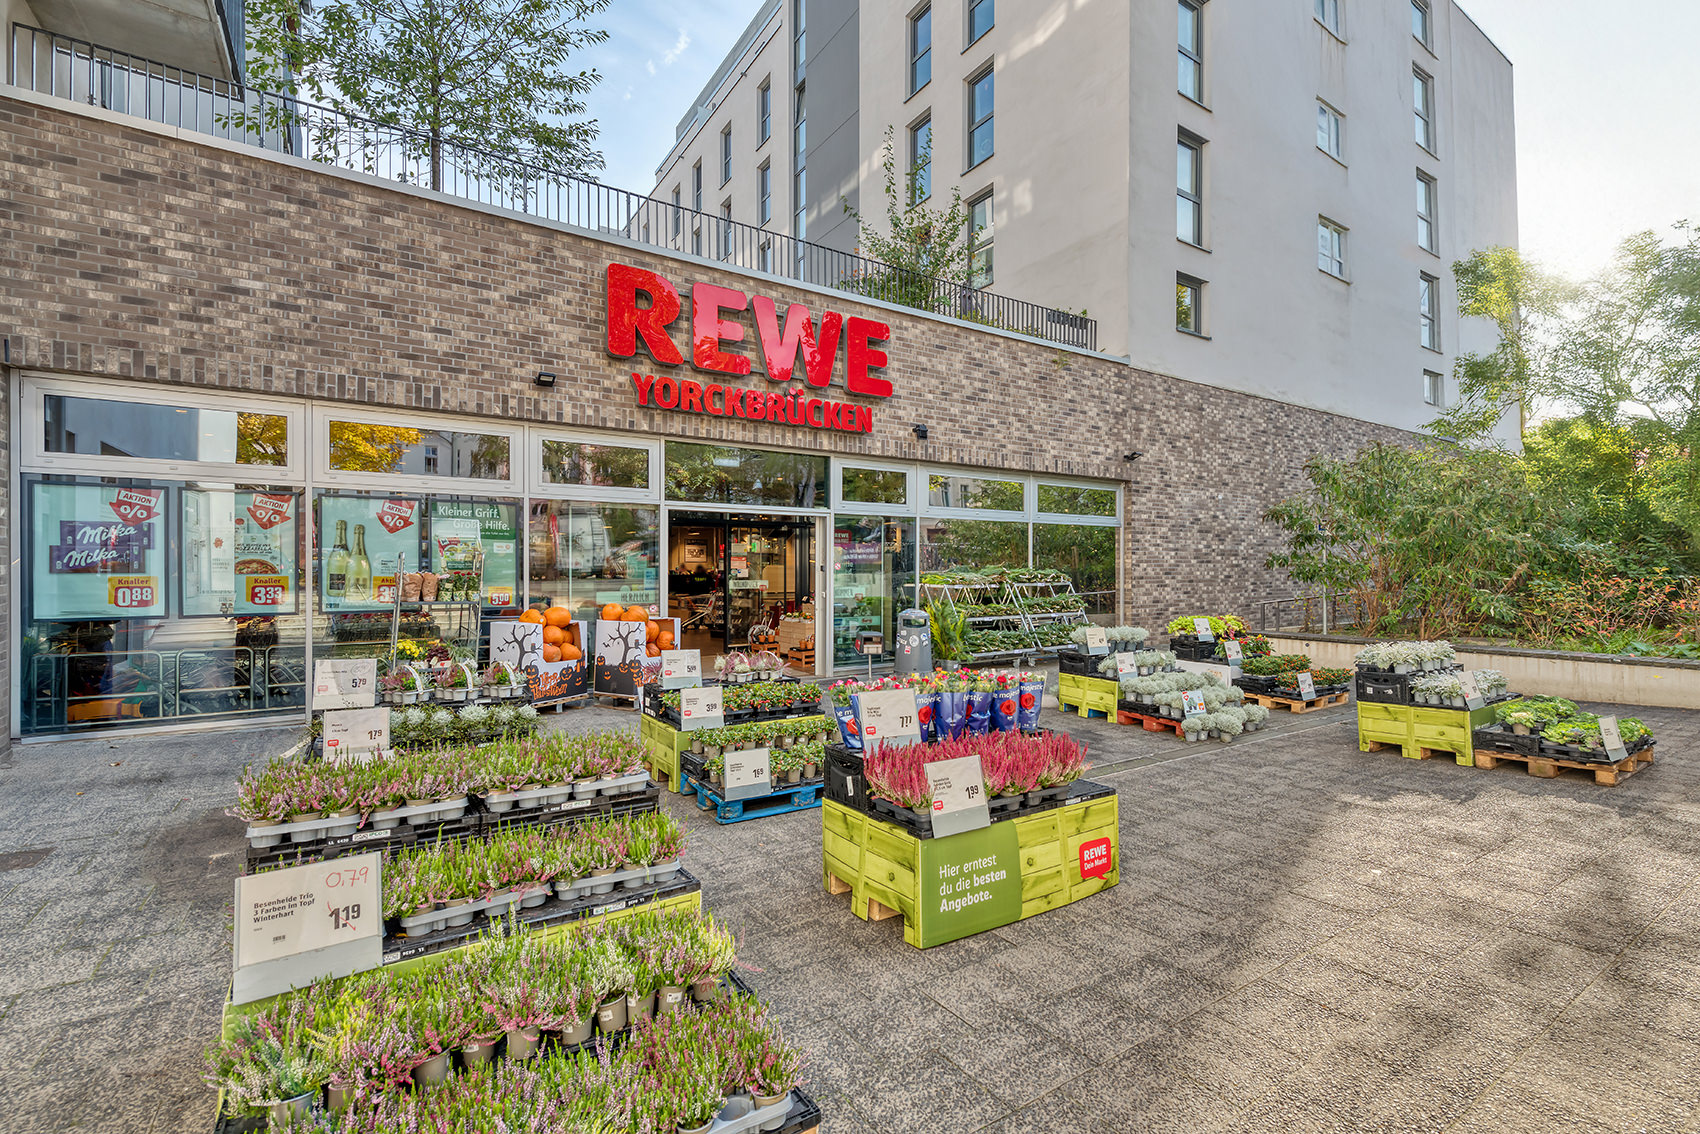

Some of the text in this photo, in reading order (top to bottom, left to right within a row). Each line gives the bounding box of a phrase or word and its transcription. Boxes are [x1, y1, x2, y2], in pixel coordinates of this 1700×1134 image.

[607, 262, 893, 398] REWE
[631, 372, 873, 433] YORCKBRÜCKEN
[123, 493, 152, 505] AKTION
[259, 499, 284, 509] AKTION
[387, 505, 409, 515] AKTION
[438, 506, 500, 519] Kleiner Griff.
[453, 520, 510, 530] Große Hilfe.
[77, 524, 138, 544] Milka
[63, 548, 119, 567] Milka
[117, 588, 152, 606] 0.88
[254, 586, 283, 604] 3.33
[492, 593, 509, 605] 5.00
[368, 729, 382, 740] 1.79
[965, 785, 979, 799] 1.99
[1083, 844, 1107, 861] REWE
[939, 854, 997, 880] Hier erntest
[1084, 856, 1107, 871] Dein Markt
[940, 869, 1007, 896] du die besten
[253, 892, 314, 909] Besenheide Trio
[260, 906, 286, 915] Farben
[299, 898, 315, 908] Topf
[940, 889, 993, 913] Angebote.
[253, 910, 294, 923] Winterhart
[328, 903, 361, 930] 1.19
